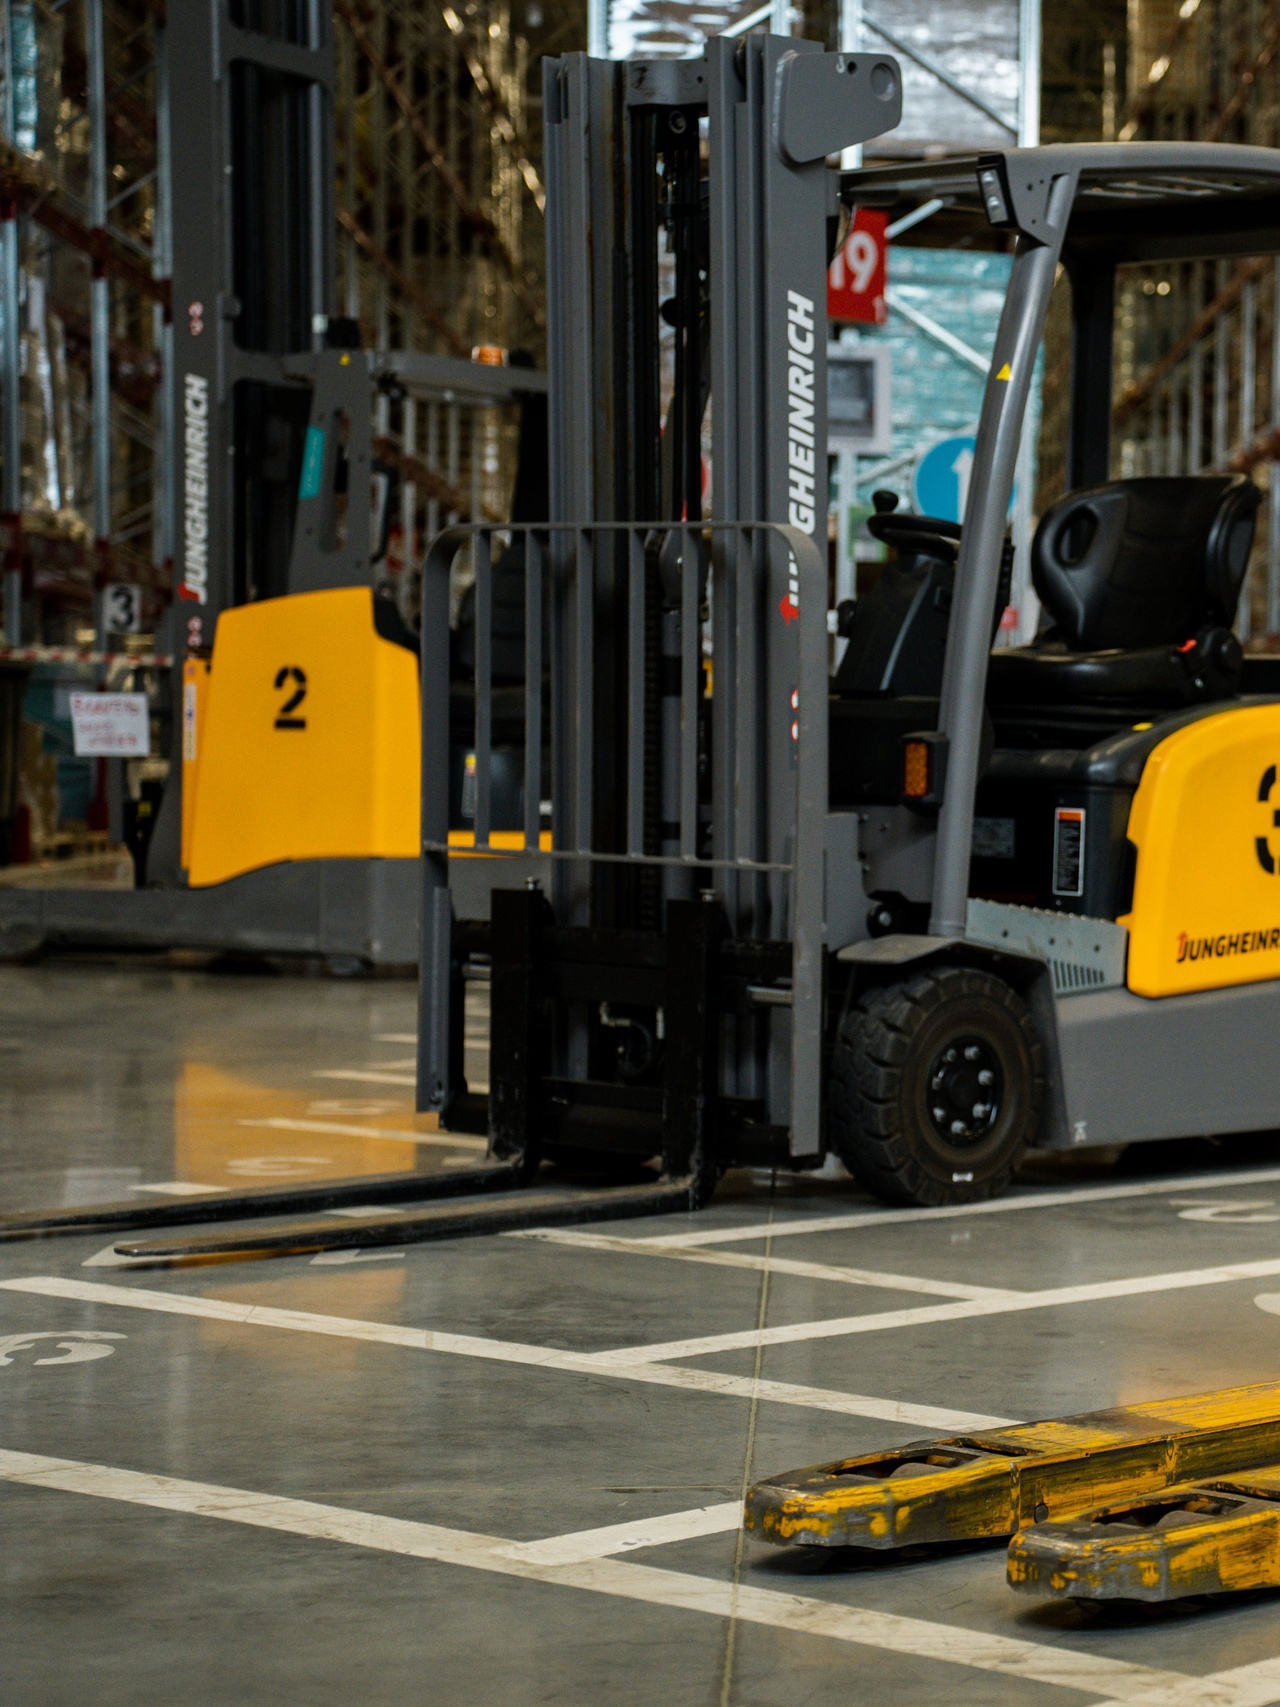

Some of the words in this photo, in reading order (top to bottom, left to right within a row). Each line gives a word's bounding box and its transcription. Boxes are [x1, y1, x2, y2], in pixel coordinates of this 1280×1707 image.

[184, 373, 208, 604] JUNGHEINRICH
[110, 584, 134, 632] 3
[274, 666, 307, 731] 2
